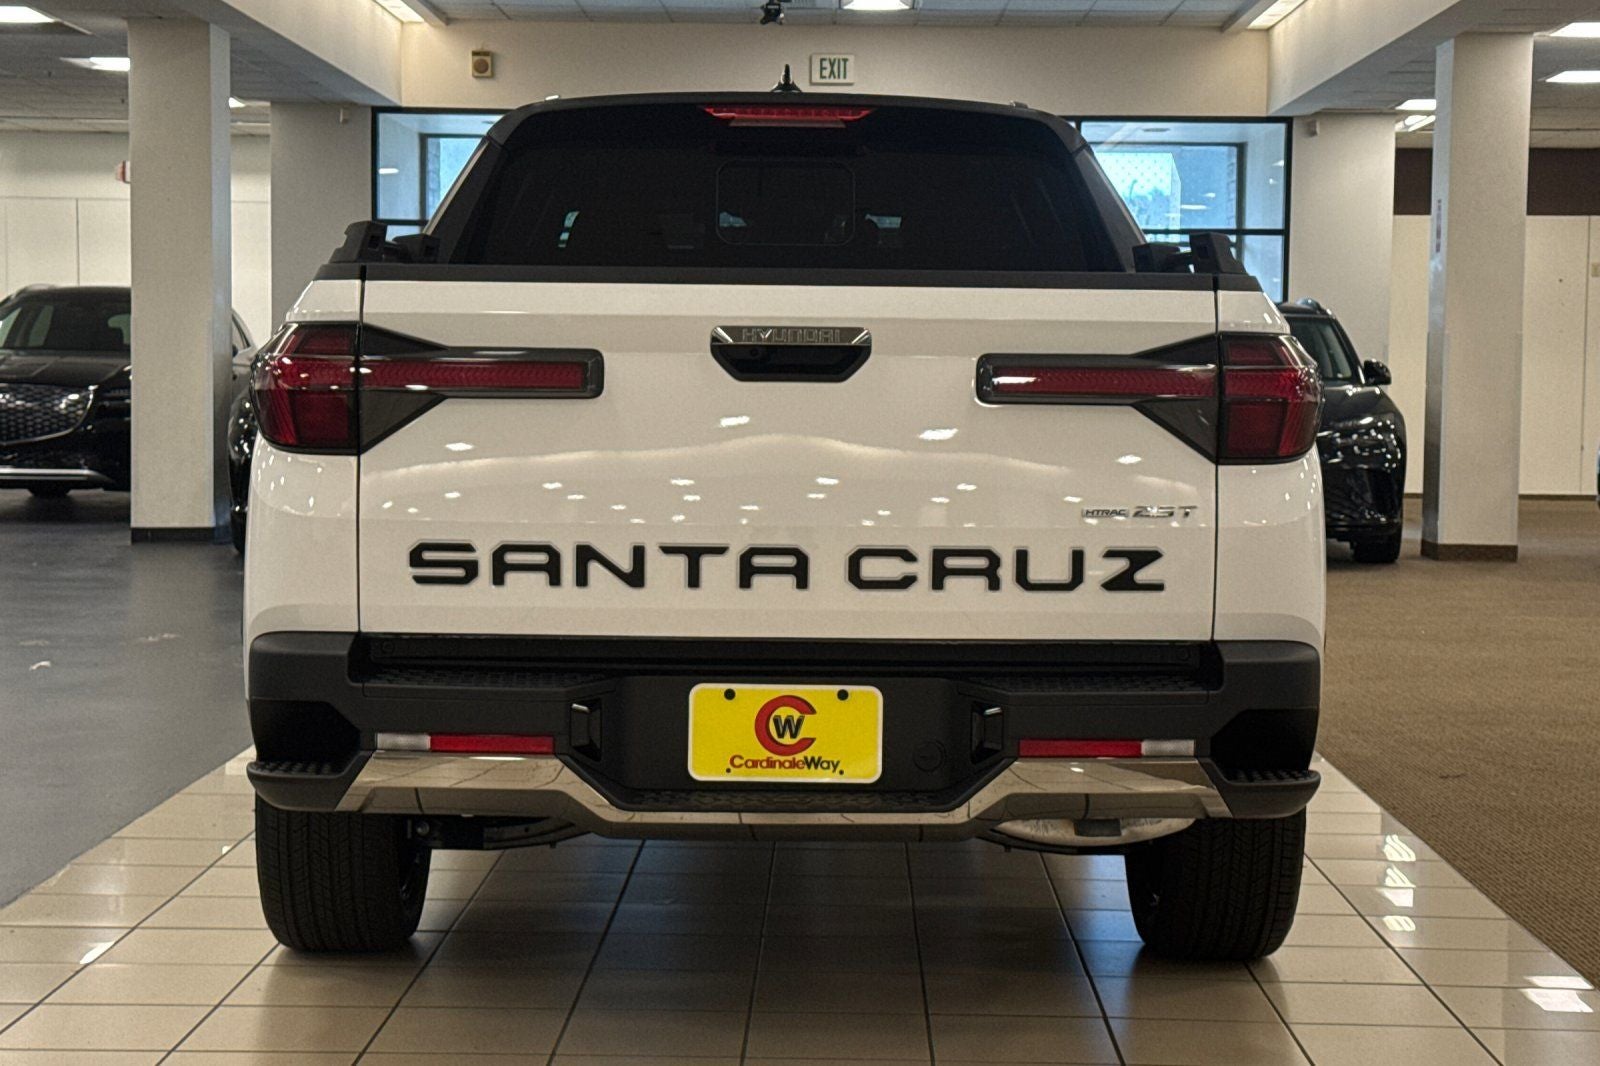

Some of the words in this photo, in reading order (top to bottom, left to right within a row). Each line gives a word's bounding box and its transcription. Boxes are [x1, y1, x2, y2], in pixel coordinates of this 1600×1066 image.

[819, 57, 849, 79] EXIT
[742, 328, 840, 343] HYUNDAI
[1085, 508, 1127, 517] HTRAC
[408, 539, 810, 590] SANTA
[845, 545, 1166, 592] CRUZ
[729, 754, 841, 773] CardinaleWay
